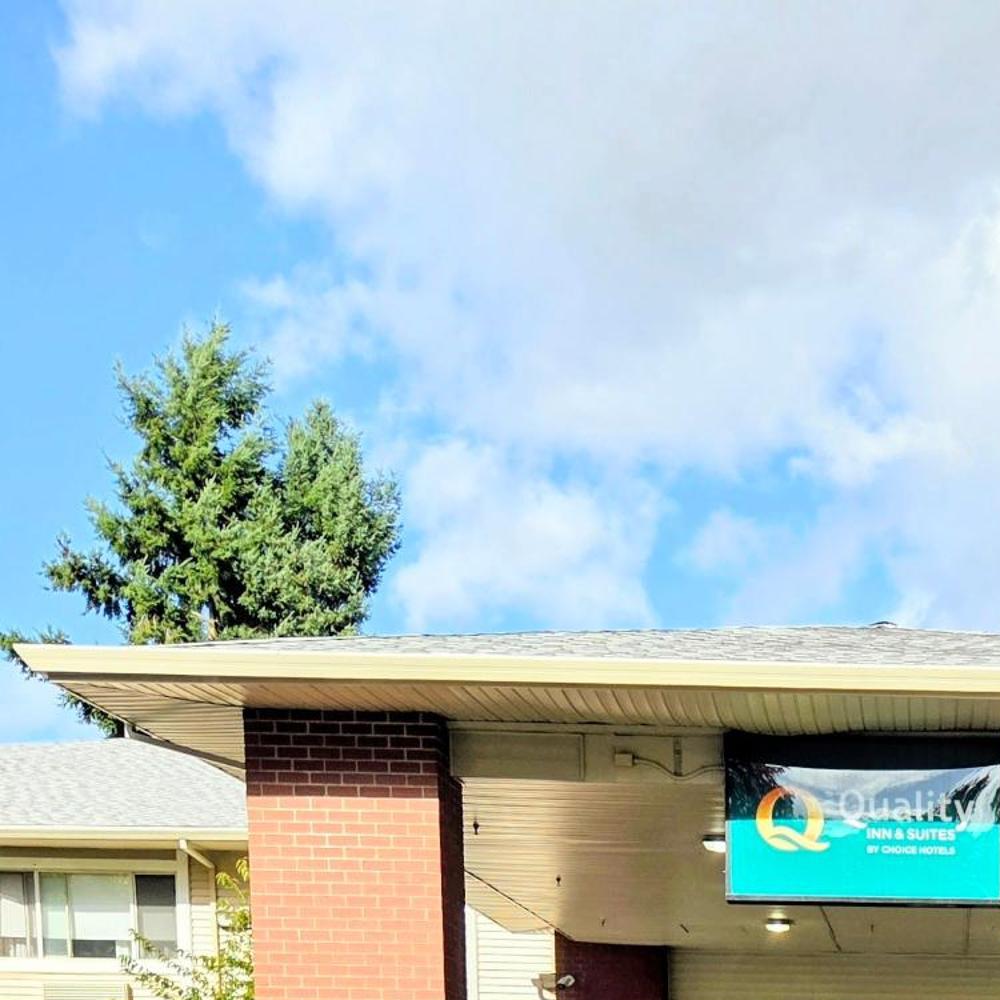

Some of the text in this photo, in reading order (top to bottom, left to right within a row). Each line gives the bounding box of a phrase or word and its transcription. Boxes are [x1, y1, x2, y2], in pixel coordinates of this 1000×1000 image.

[840, 788, 975, 832] Quality
[866, 828, 956, 841] INN & SUITES
[866, 845, 956, 855] BY CHOICE HOTELS
